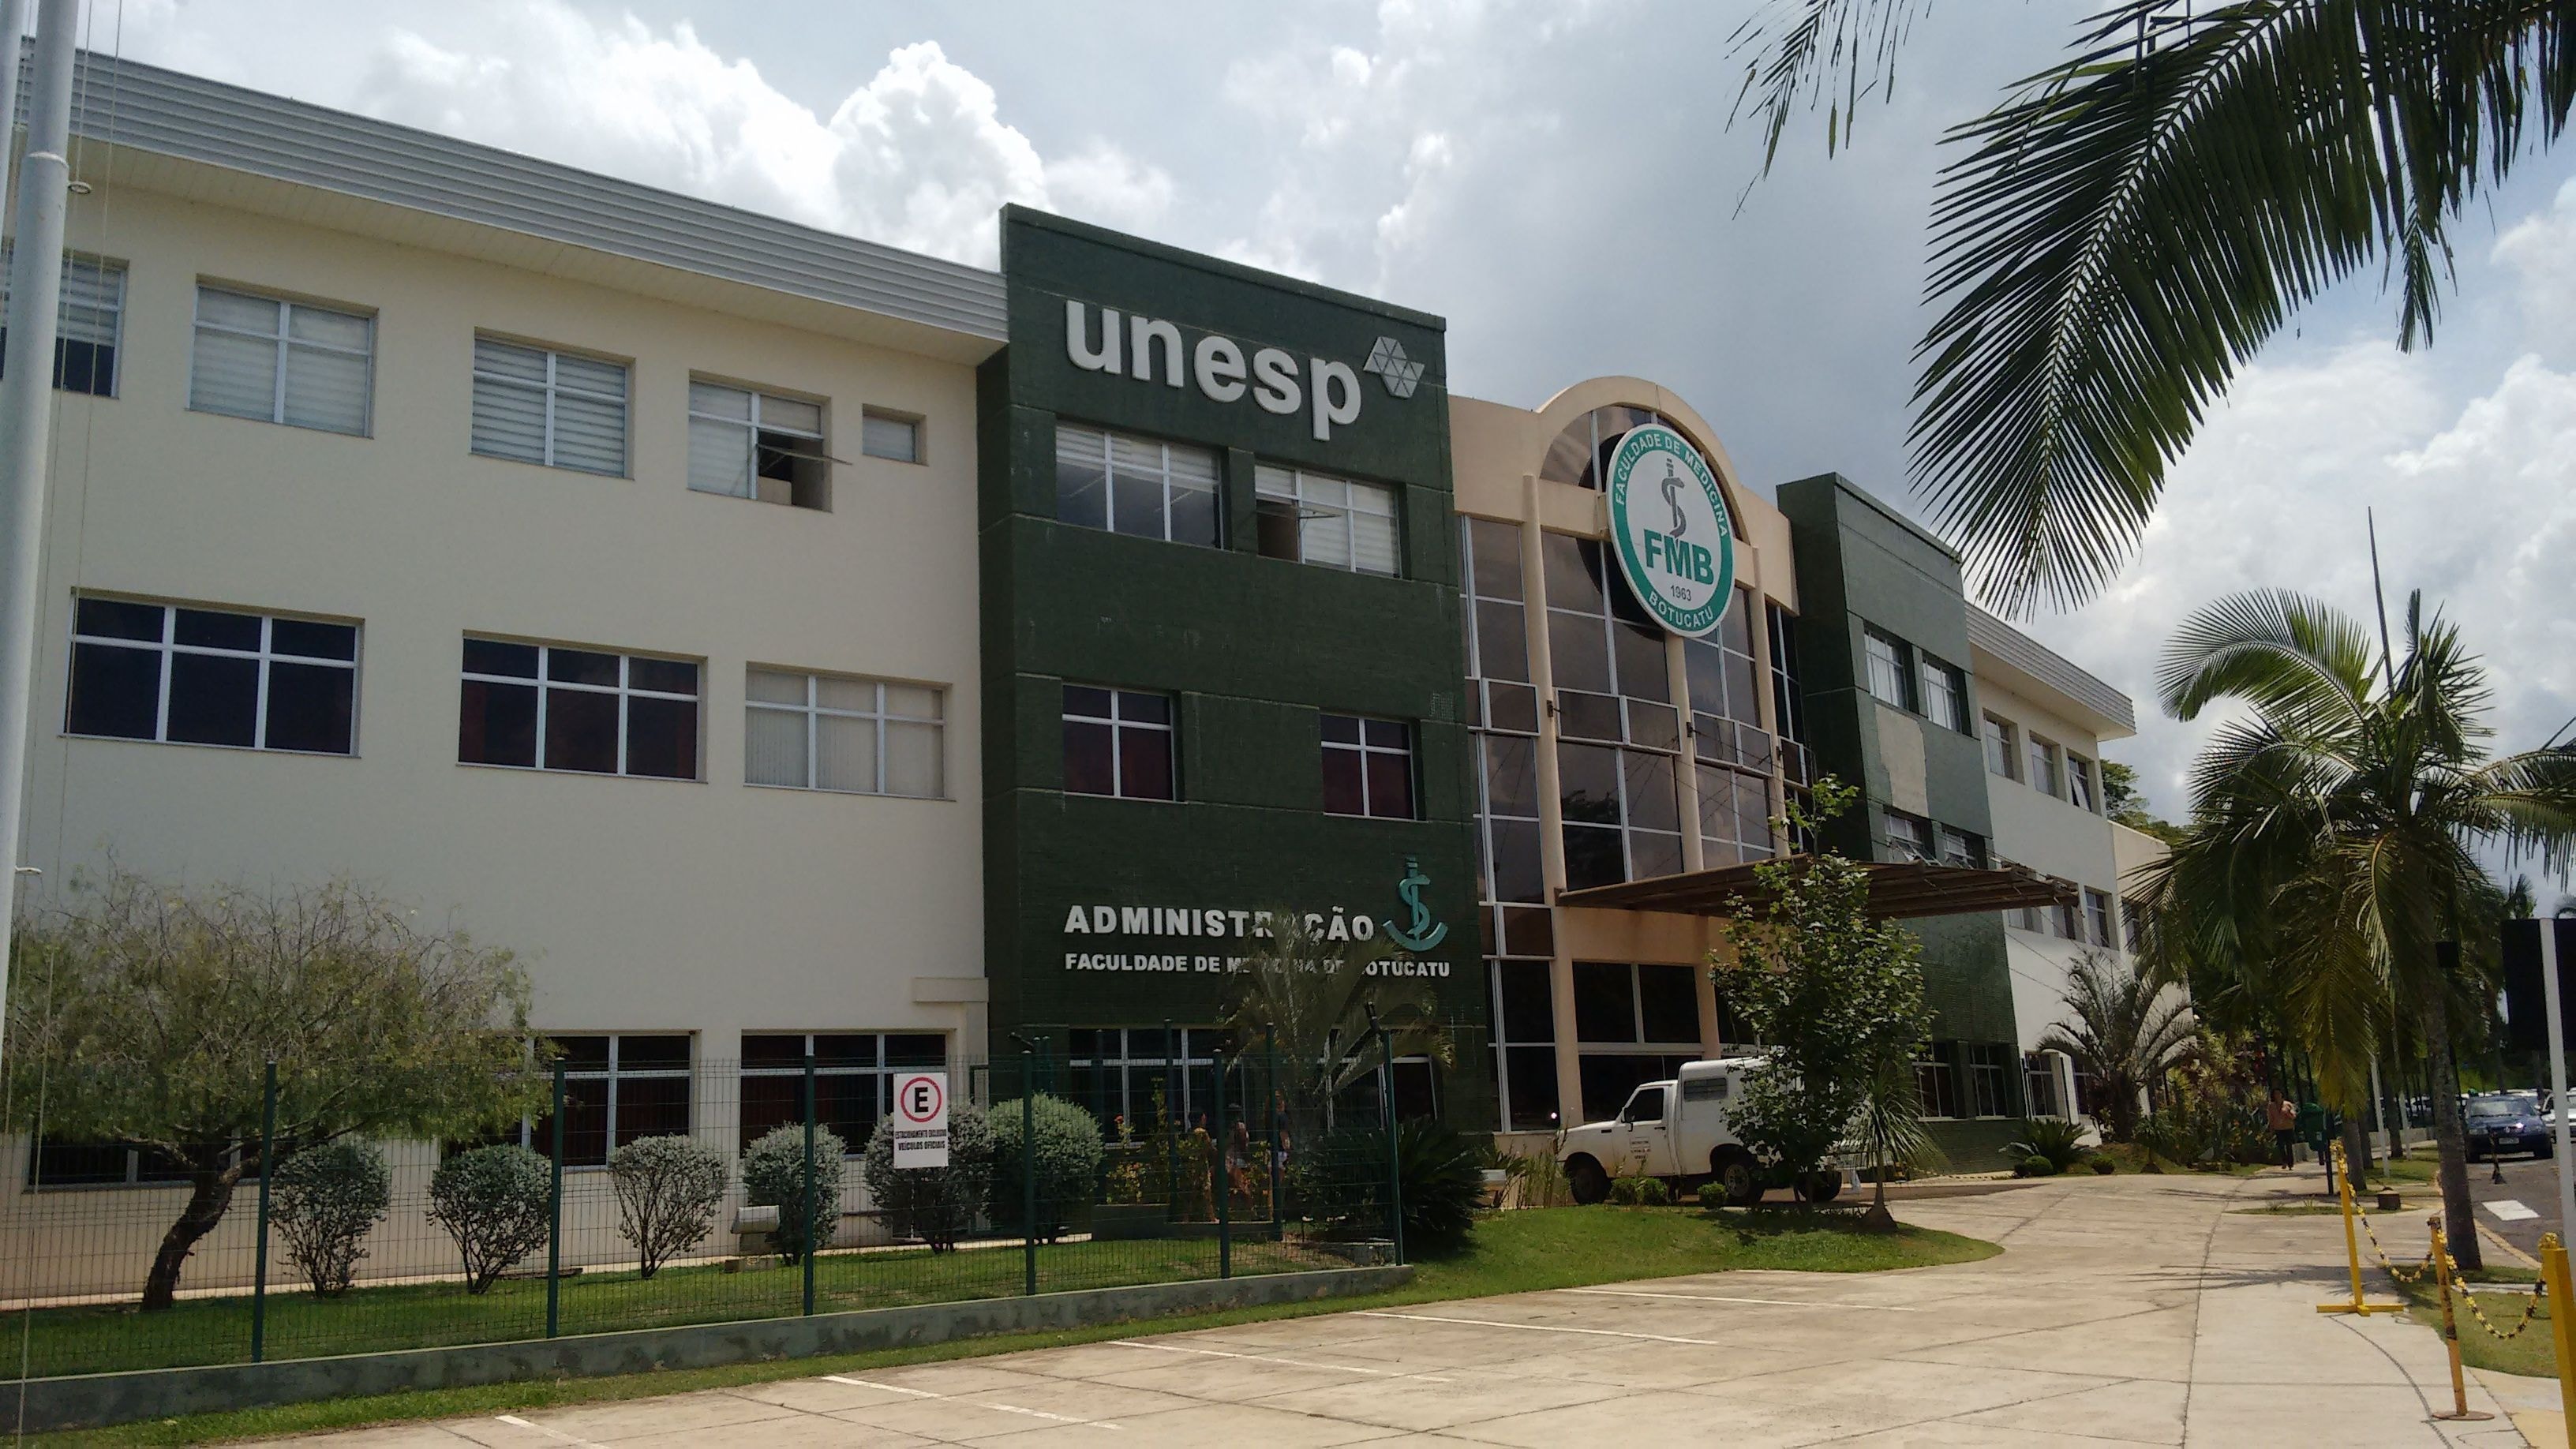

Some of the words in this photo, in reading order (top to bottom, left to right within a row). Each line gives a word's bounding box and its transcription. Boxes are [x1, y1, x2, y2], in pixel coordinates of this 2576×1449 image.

[1065, 299, 1362, 441] unesp
[1616, 433, 1661, 506] FACULDADE
[1664, 436, 1681, 455] DE
[1684, 451, 1728, 537] MEDICINA
[1643, 528, 1715, 586] FMB
[1648, 590, 1714, 628] BOTUCATU
[1670, 584, 1692, 602] 1963
[1065, 953, 1188, 972] FACULDADE
[1194, 956, 1221, 973] DE
[1357, 960, 1451, 978] OTUCATU
[914, 1086, 929, 1114] E
